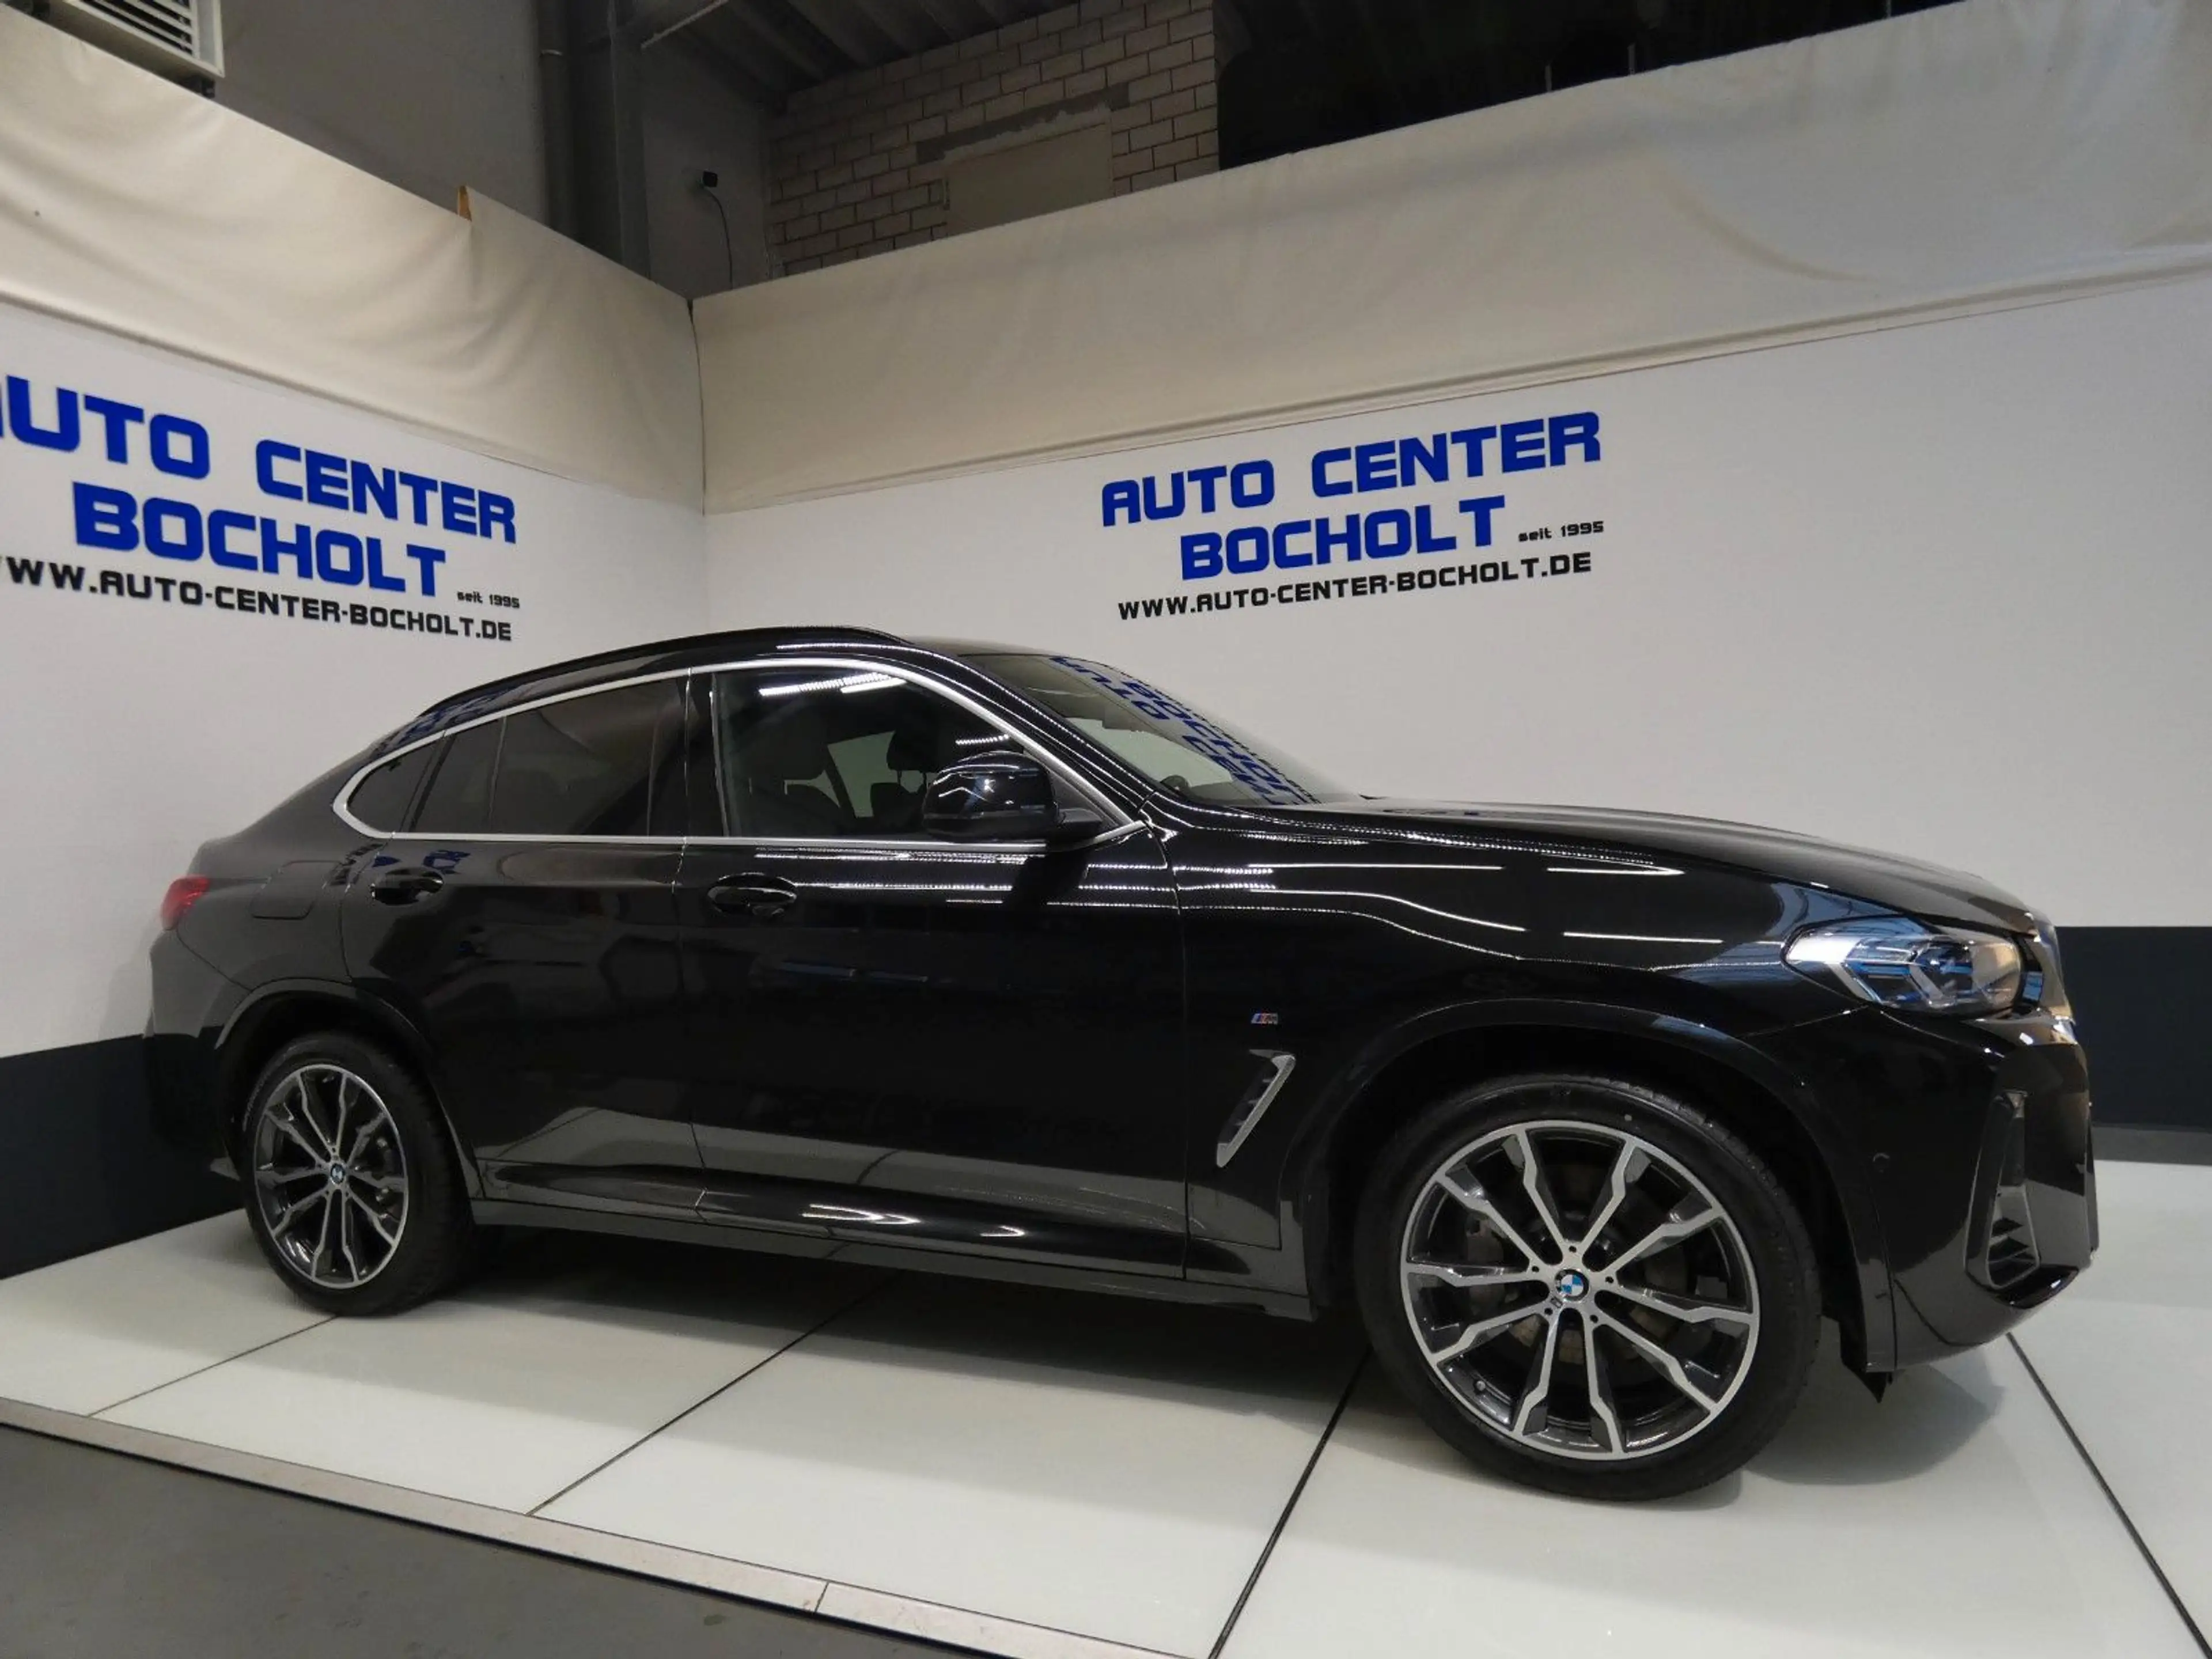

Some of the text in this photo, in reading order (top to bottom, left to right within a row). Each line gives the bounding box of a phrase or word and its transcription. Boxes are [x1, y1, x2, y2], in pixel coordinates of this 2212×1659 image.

[0, 376, 517, 544] UTO CENTER
[1102, 412, 1601, 527] AUTO CENTER
[73, 481, 520, 609] BOCHOLT seit 1995
[1118, 551, 1592, 620] WWW.AUTO-CENTER-BOCHOLT.DE
[1180, 495, 1604, 581] BOCHOLT seit 1995
[0, 555, 512, 641] WW.AUTO-CENTER-BOCHOLT.DE
